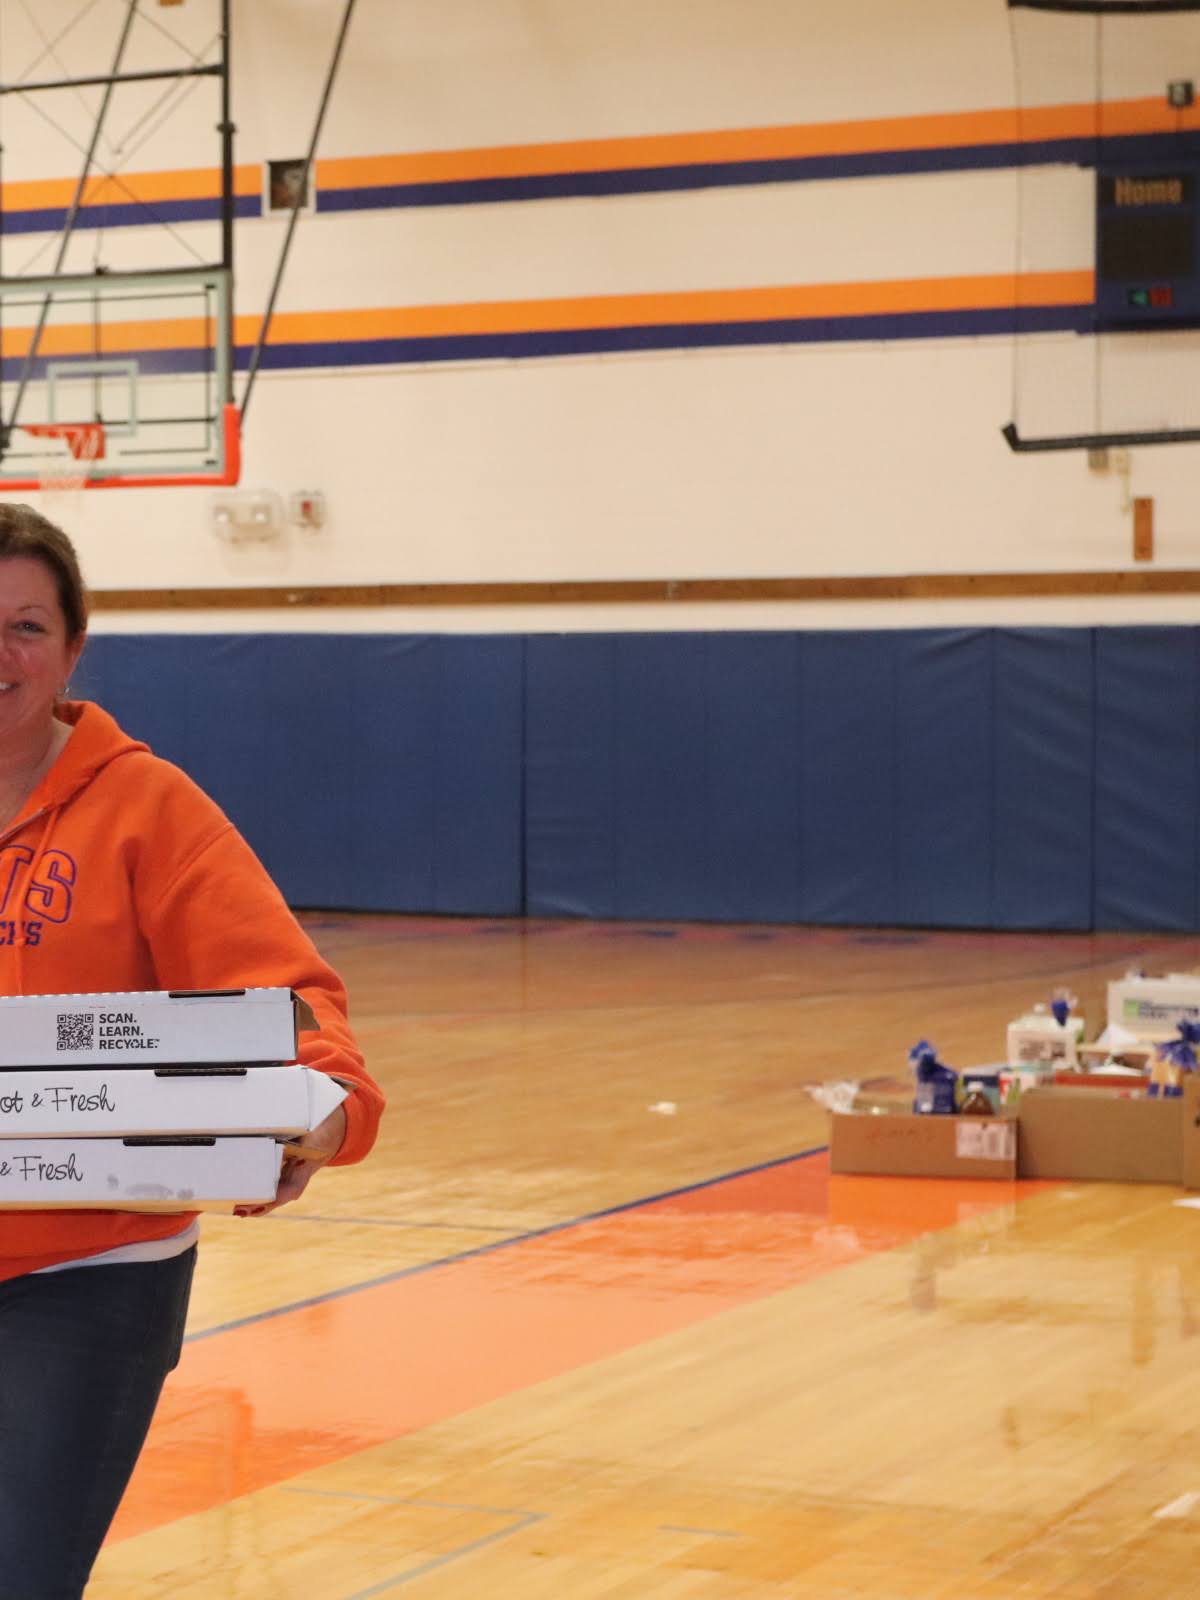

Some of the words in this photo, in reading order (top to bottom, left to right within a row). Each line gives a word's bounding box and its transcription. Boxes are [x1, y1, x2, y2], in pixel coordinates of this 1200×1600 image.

[1114, 177, 1183, 206] Home
[99, 1012, 138, 1024] SCAN.
[99, 1025, 145, 1037] LEARN.
[31, 1092, 43, 1107] &
[44, 1083, 116, 1112] Fresh
[0, 1161, 12, 1176] &
[13, 1152, 84, 1182] Fresh
